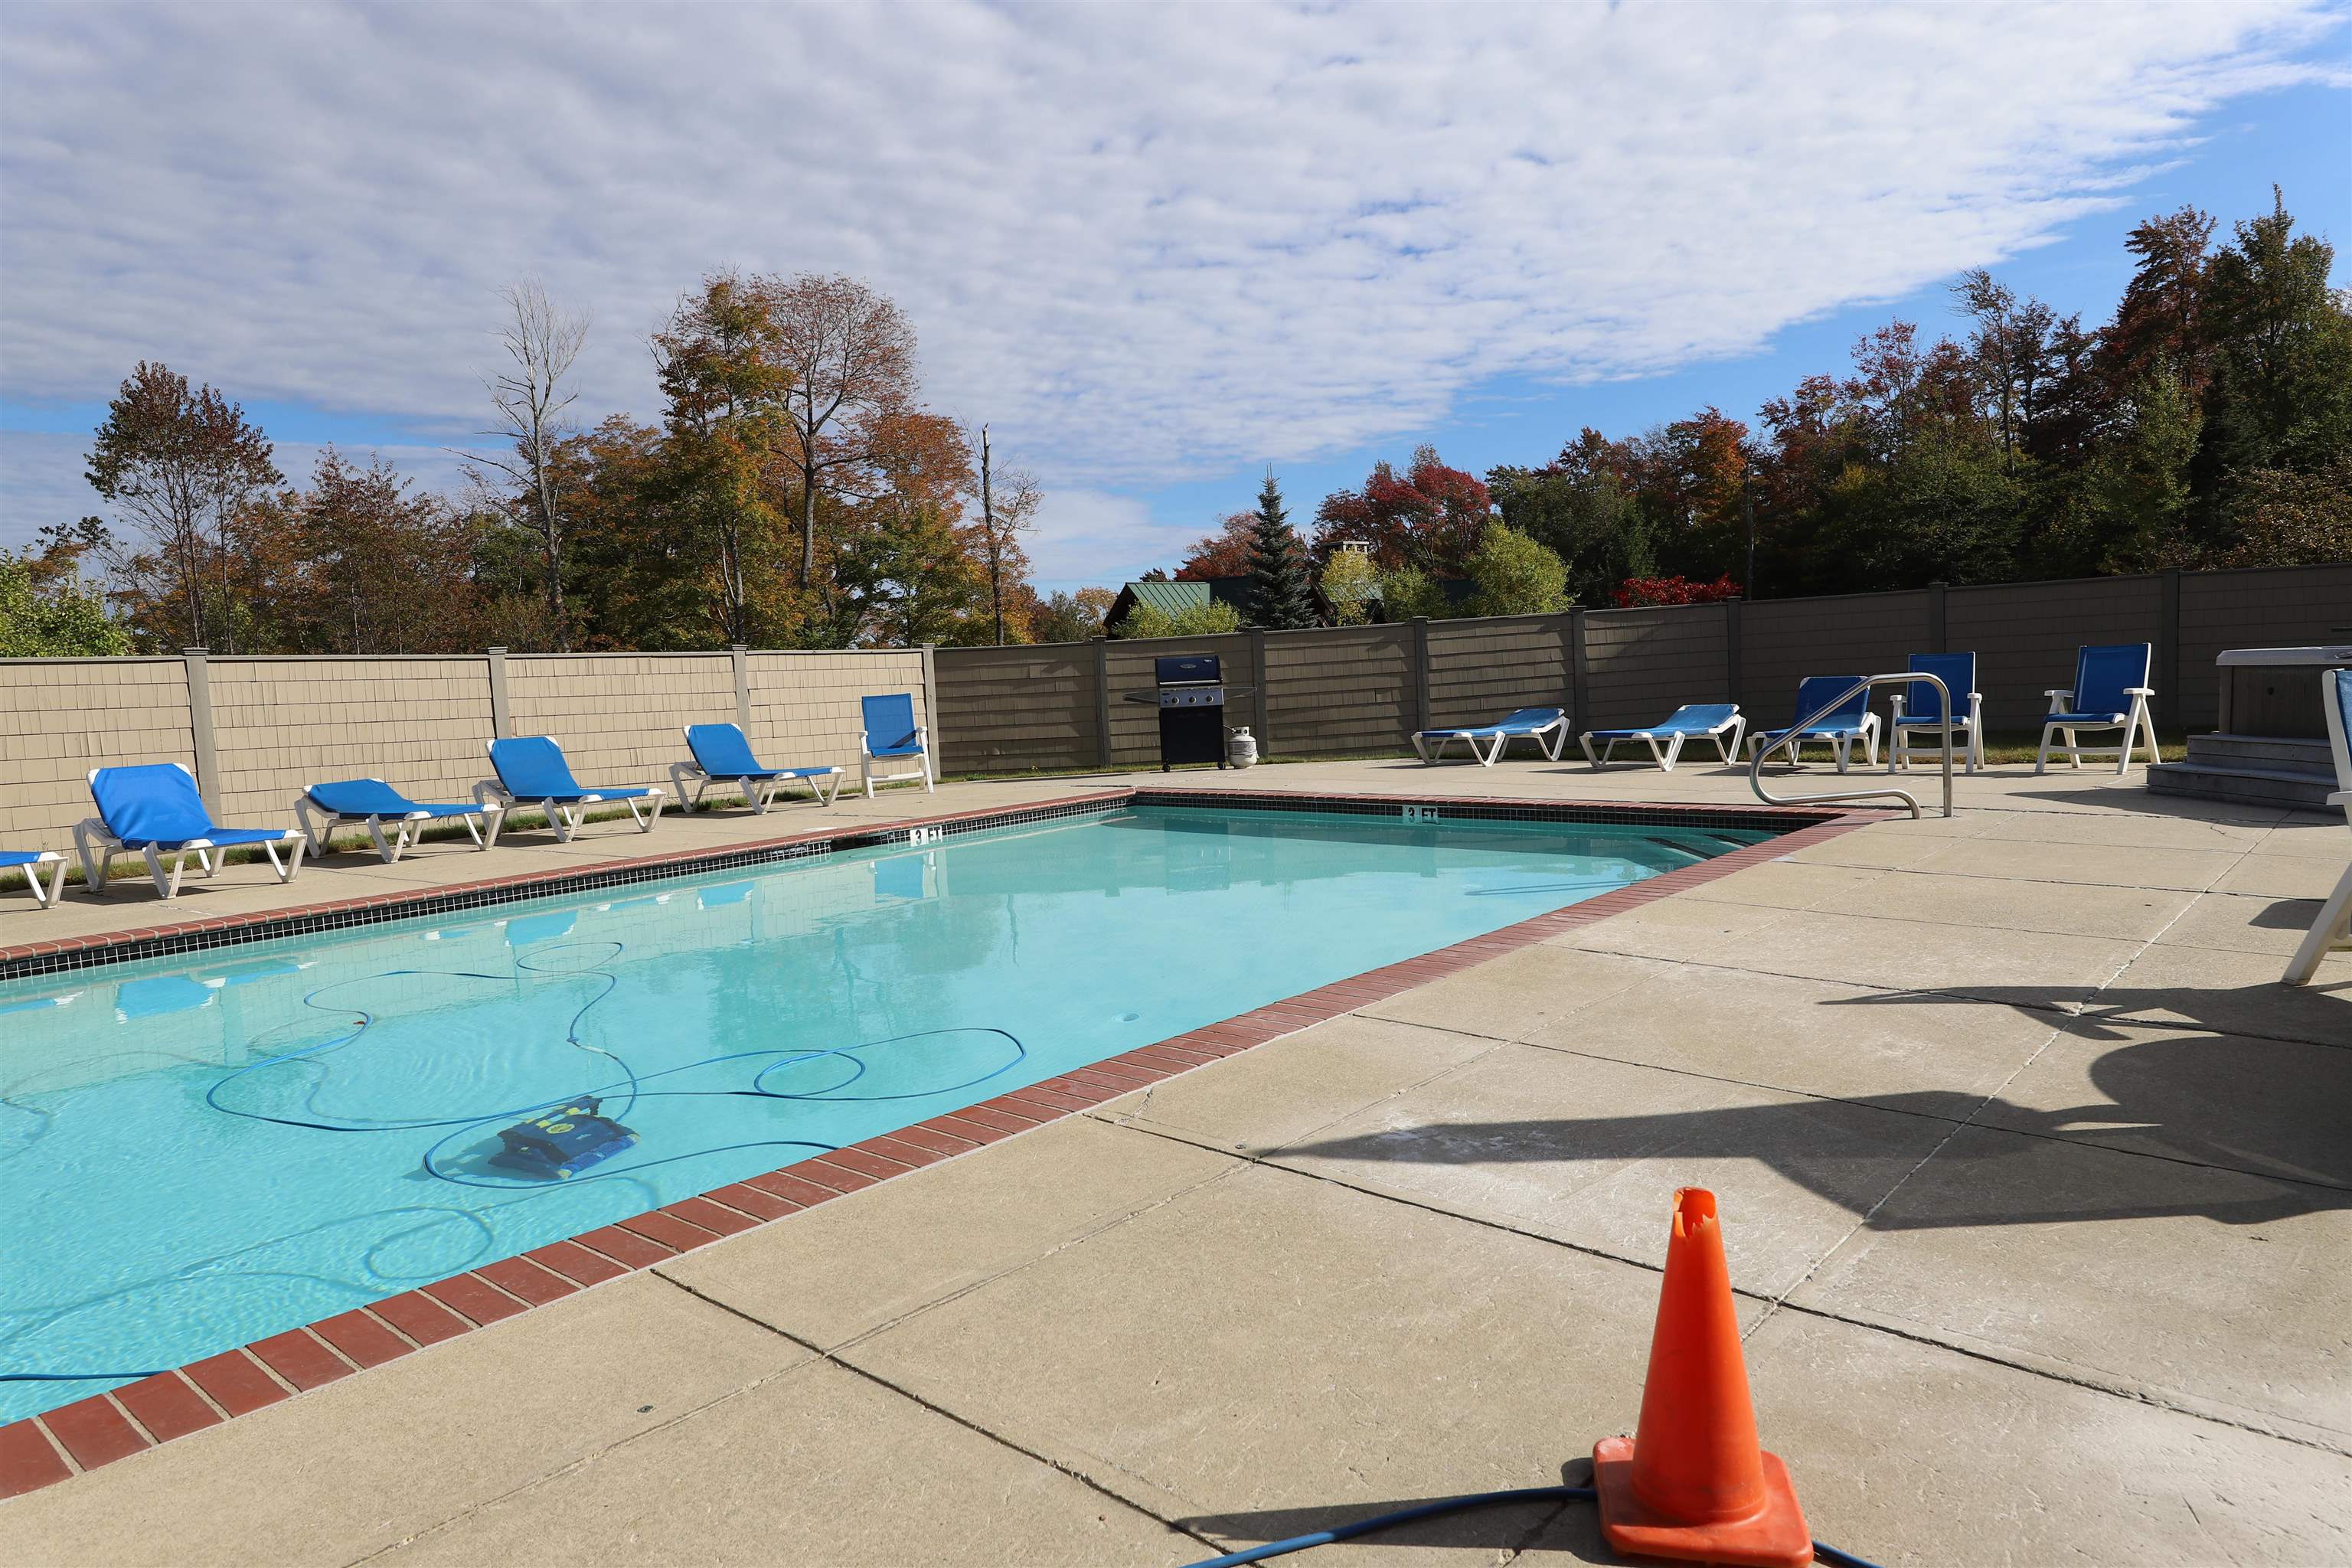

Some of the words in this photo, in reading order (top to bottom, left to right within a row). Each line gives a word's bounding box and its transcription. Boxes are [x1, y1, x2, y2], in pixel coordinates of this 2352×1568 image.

[1408, 807, 1415, 823] 3
[1421, 808, 1436, 820] FT
[915, 829, 922, 845] 3
[927, 827, 941, 842] FT
